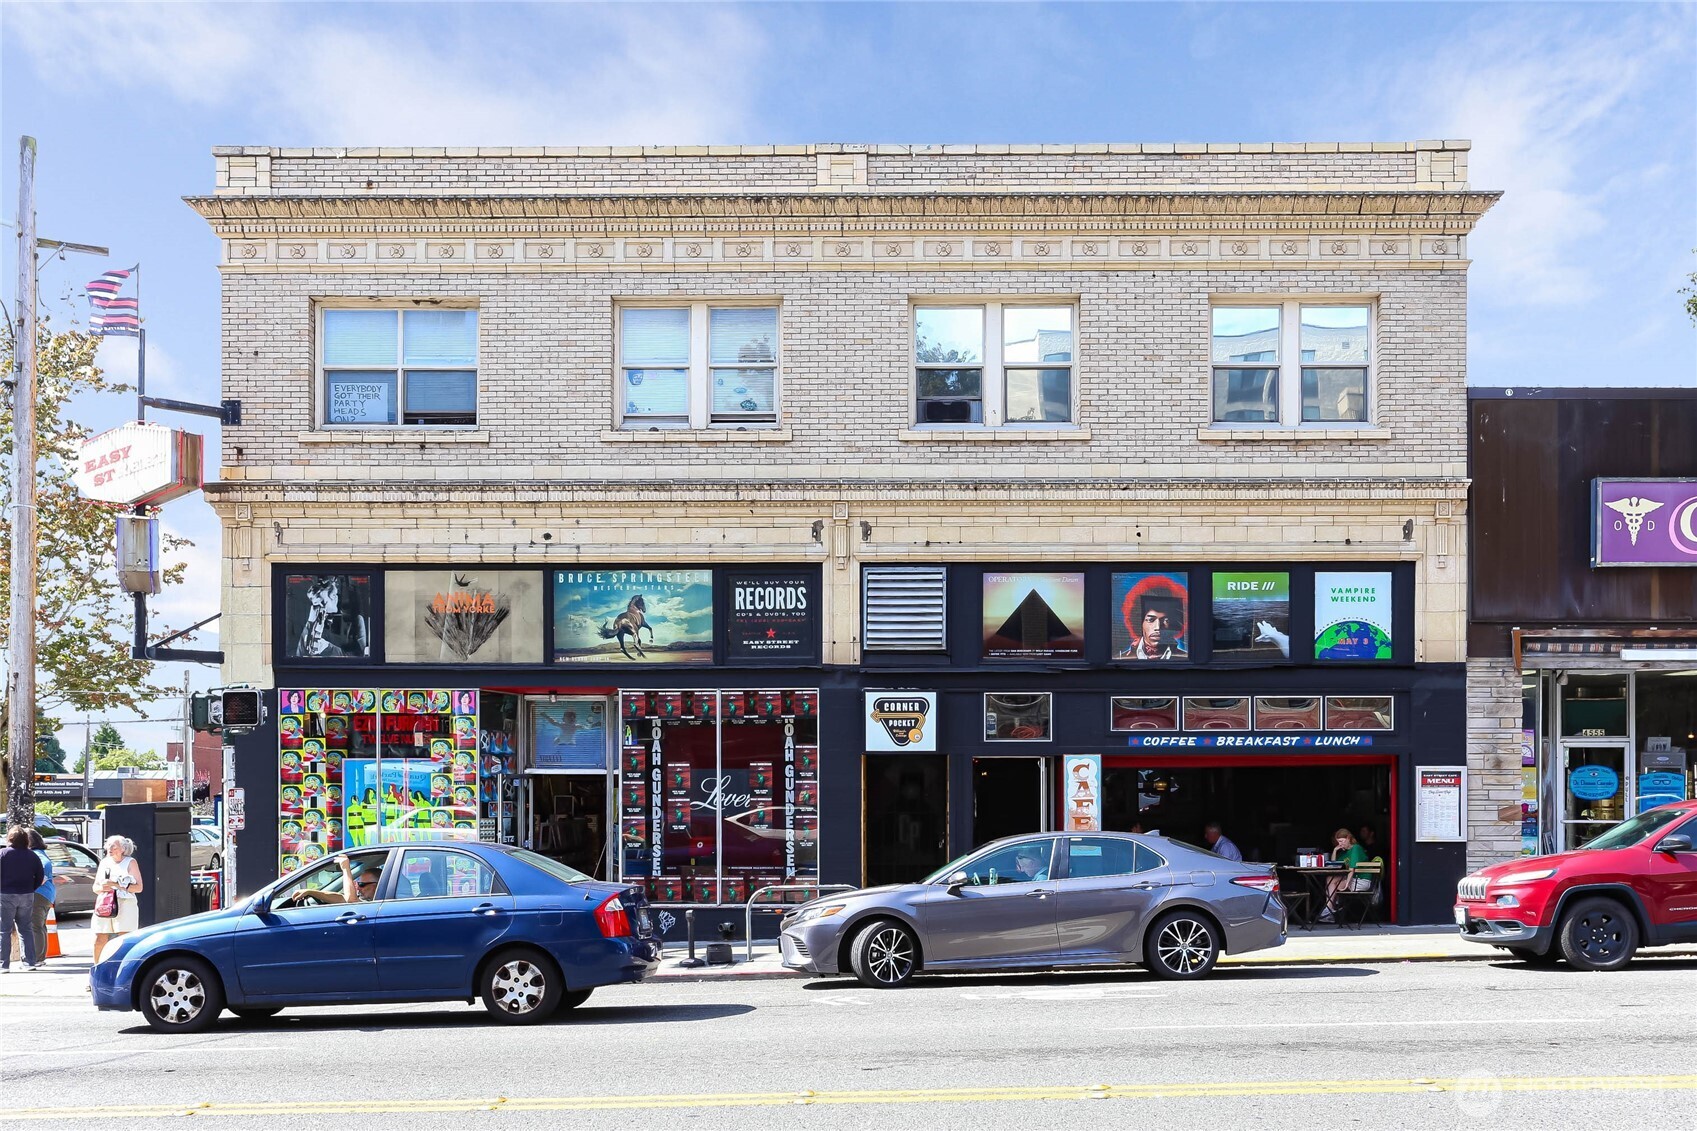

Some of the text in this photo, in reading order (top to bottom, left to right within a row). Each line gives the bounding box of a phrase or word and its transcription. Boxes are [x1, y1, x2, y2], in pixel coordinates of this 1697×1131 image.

[334, 384, 382, 392] EVERYBODY
[334, 408, 367, 416] HEADS
[84, 444, 133, 474] EASY
[558, 572, 709, 584] BRUCE SPRINGSTEEN
[1227, 581, 1259, 591] RIDE
[433, 591, 497, 606] ANIMA
[735, 586, 808, 610] RECORDS
[463, 605, 496, 614] YORKE
[1362, 637, 1370, 645] 3
[884, 702, 920, 712] CORNER
[888, 719, 916, 727] POCKET
[1582, 728, 1605, 736] 4555
[1143, 736, 1361, 746] COFFEE BREAKFAST LUNCH
[690, 775, 751, 811] Lover
[1070, 763, 1096, 830] CAFE
[784, 764, 796, 877] GUNDERSEN
